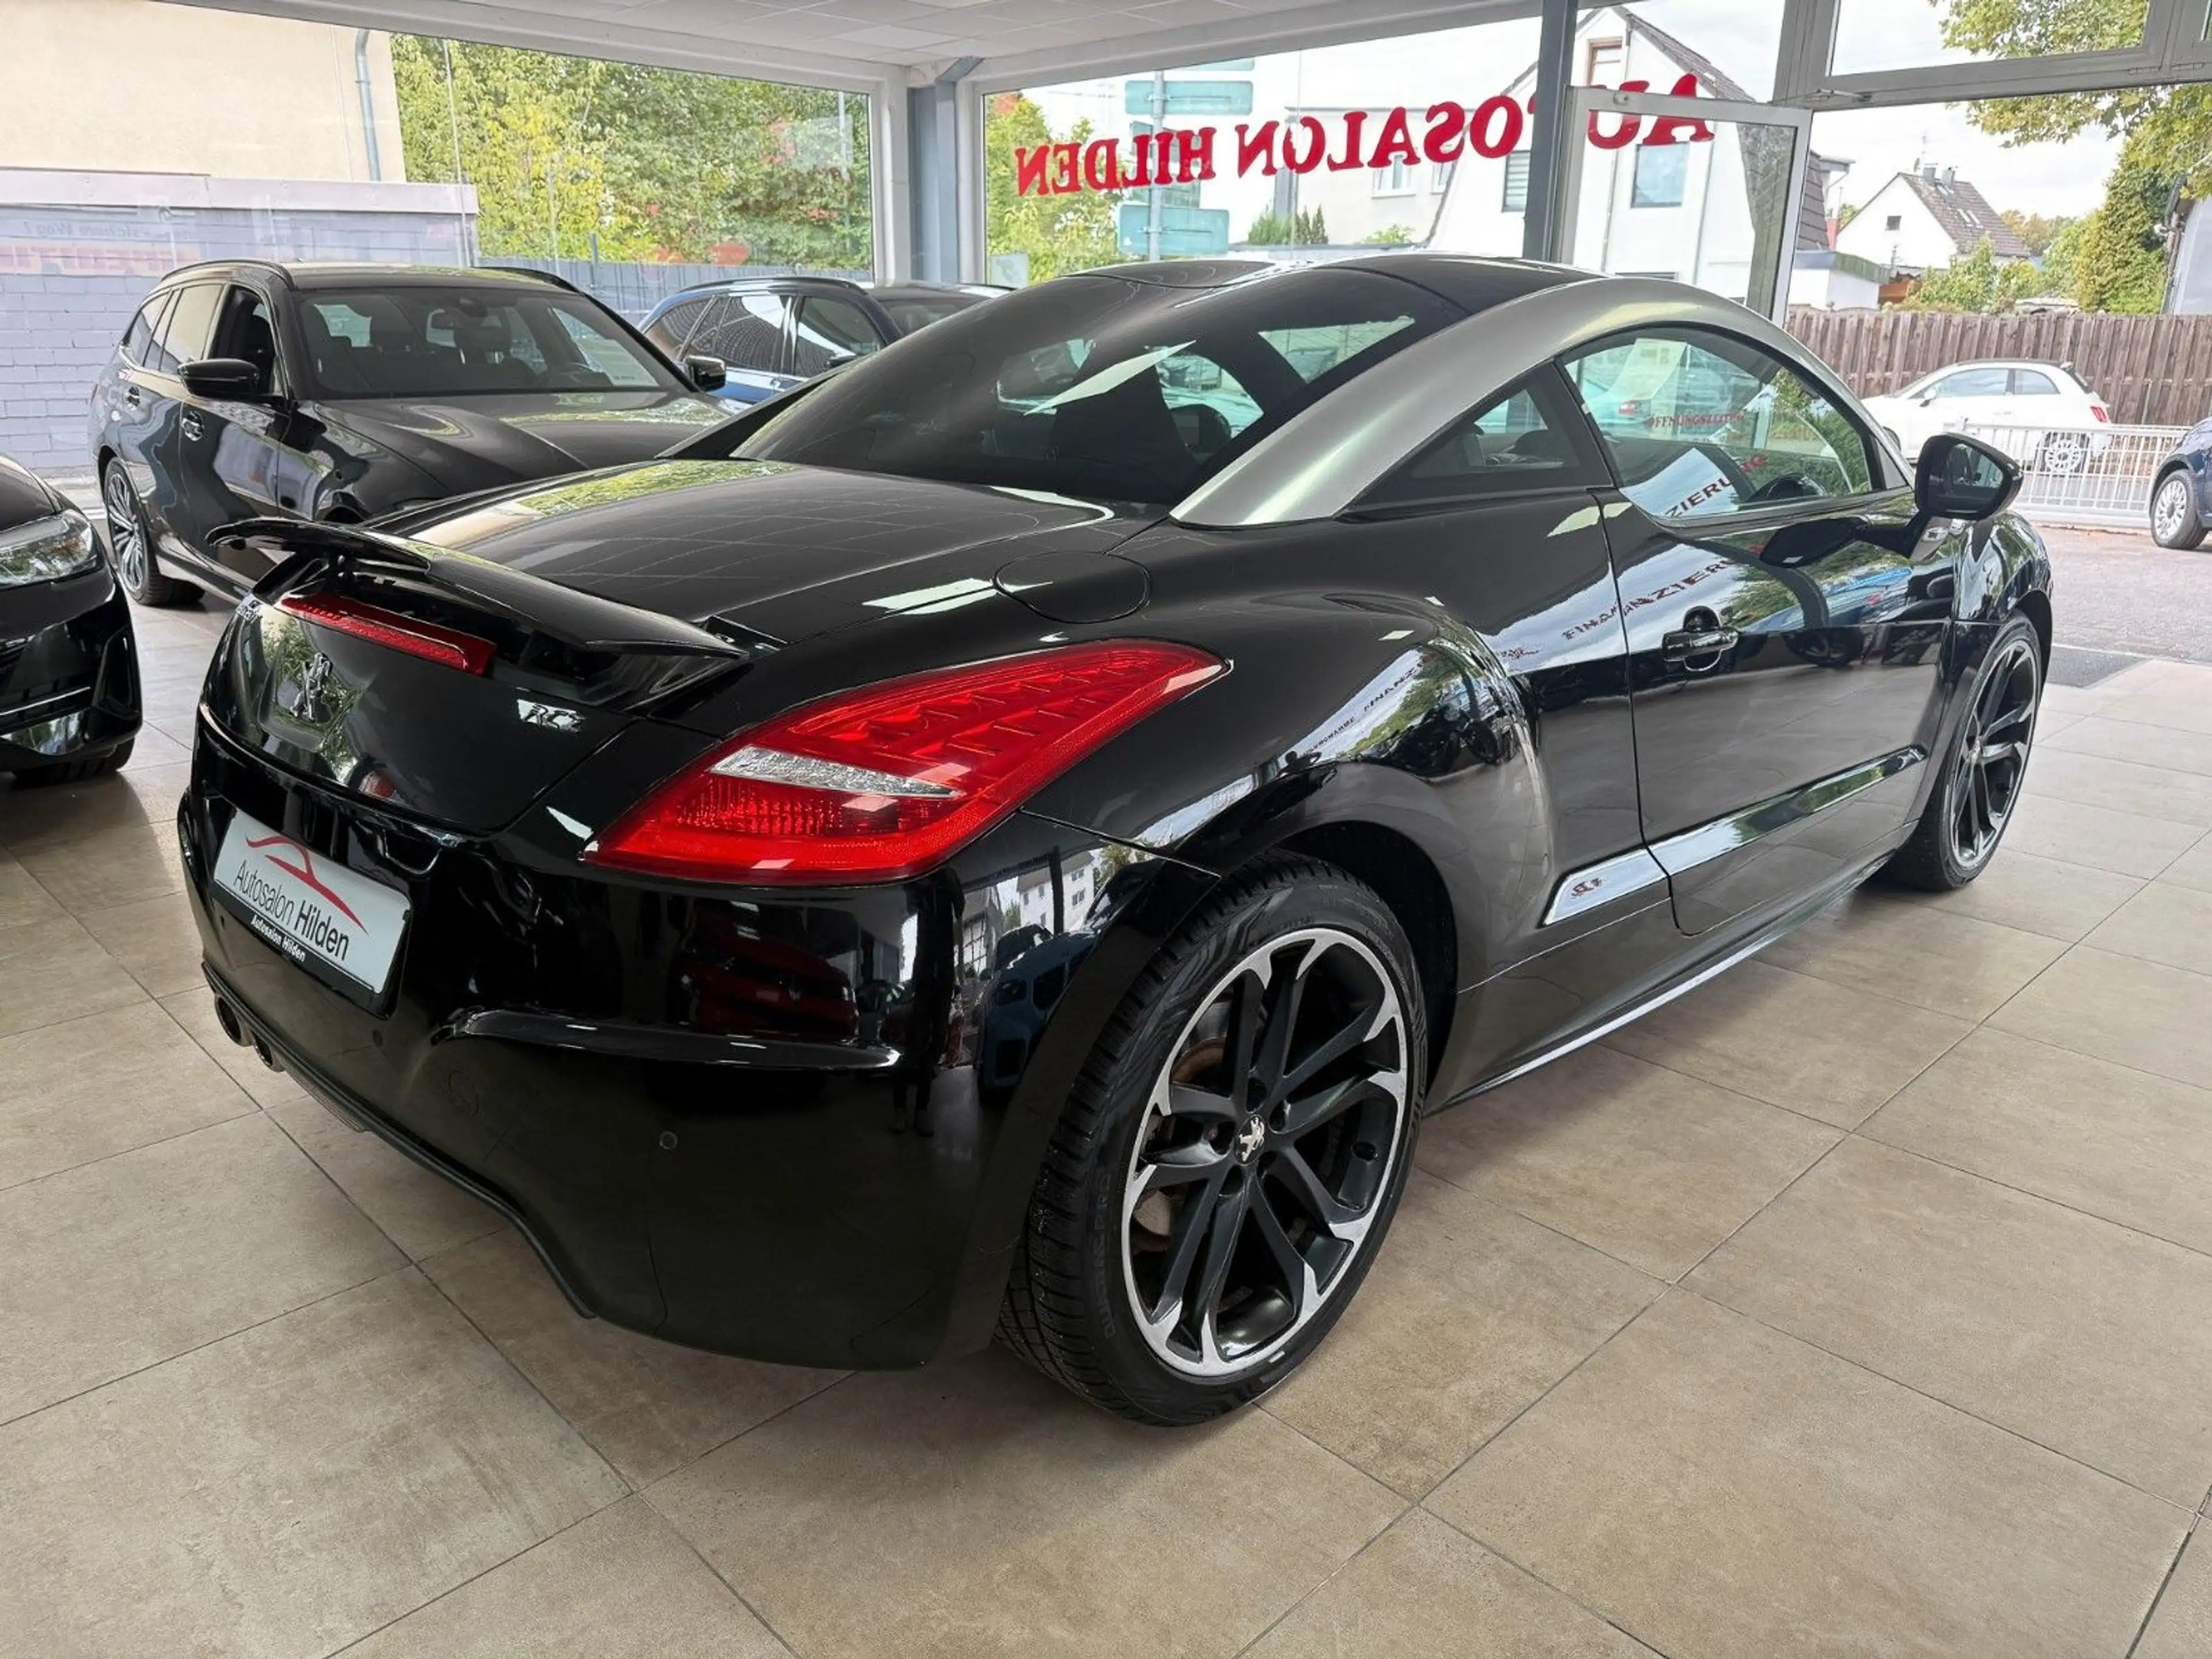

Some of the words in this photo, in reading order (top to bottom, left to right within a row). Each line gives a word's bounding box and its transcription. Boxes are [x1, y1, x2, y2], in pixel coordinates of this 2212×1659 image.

[234, 860, 294, 925] Autosalon
[294, 900, 349, 961] Hilden
[251, 915, 282, 945] Autosalon
[282, 936, 306, 963] Hilden
